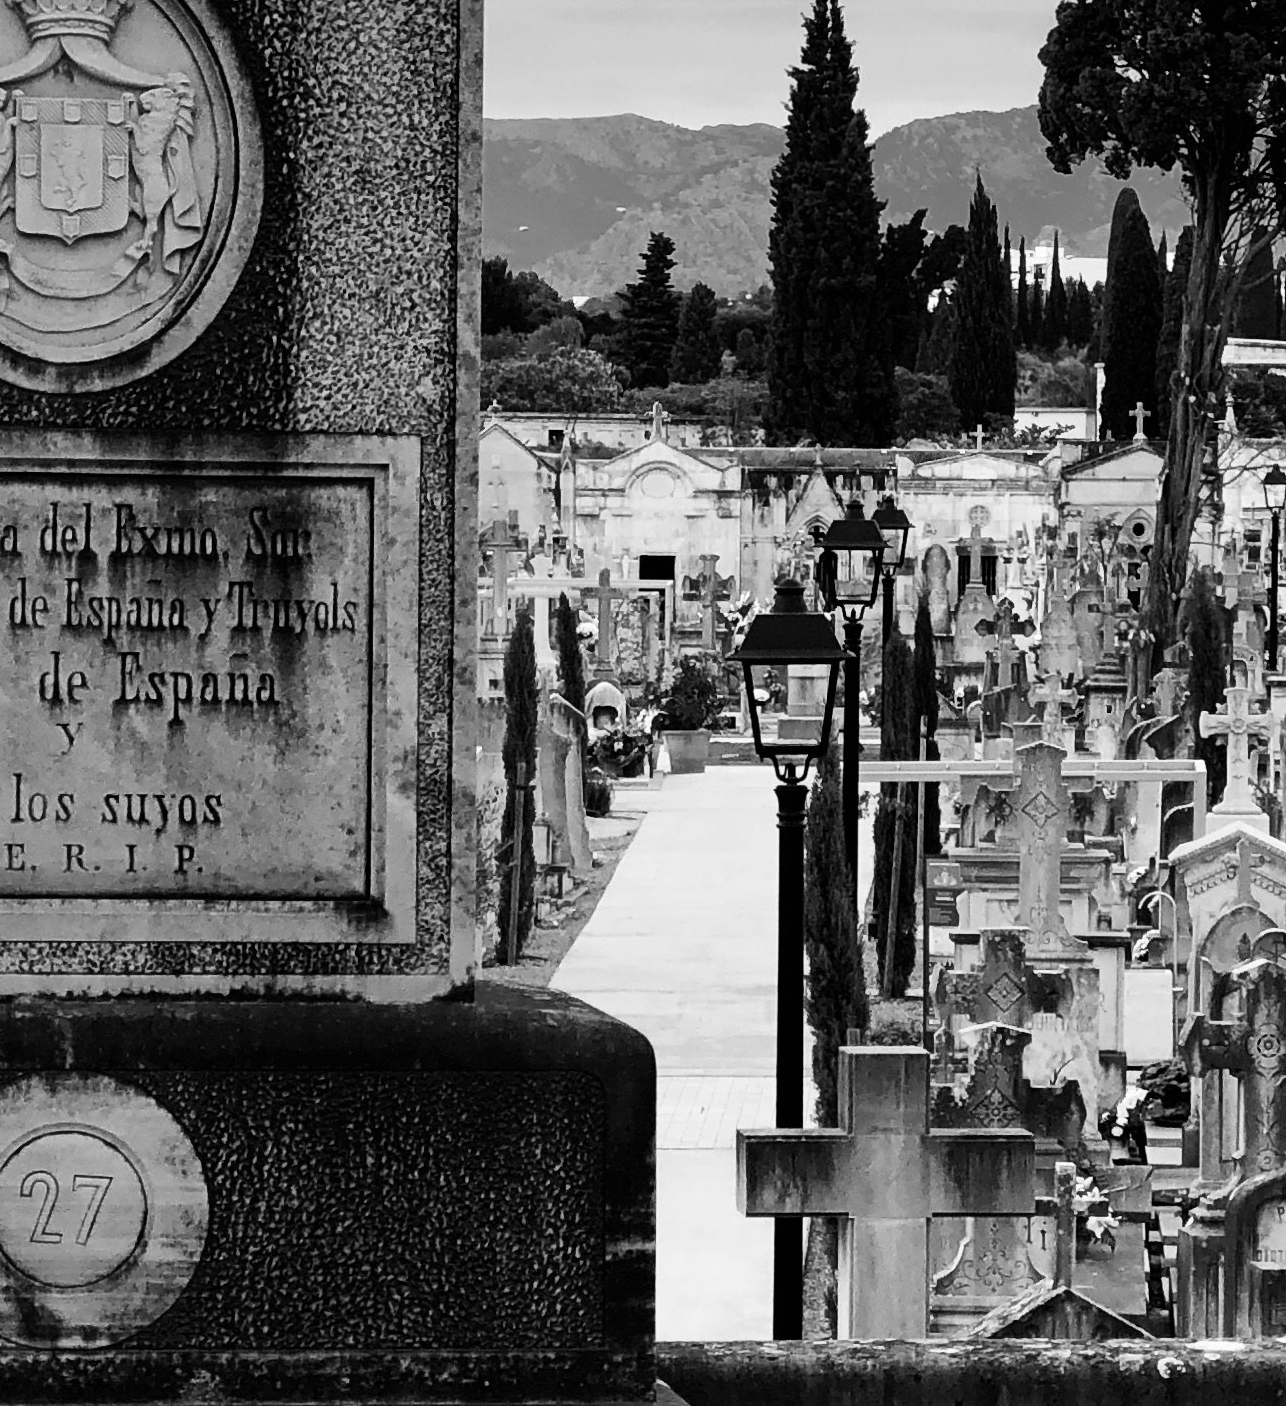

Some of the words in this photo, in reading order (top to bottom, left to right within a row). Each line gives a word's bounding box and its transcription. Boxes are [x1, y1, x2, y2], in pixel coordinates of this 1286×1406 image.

[39, 501, 94, 557] del
[9, 576, 50, 631] de
[62, 577, 190, 645] España
[199, 597, 222, 641] y
[227, 580, 358, 637] Truyols
[38, 650, 90, 704] de
[112, 650, 281, 726] España
[55, 721, 85, 756] y
[10, 772, 76, 824] los
[101, 792, 224, 837] suyos
[19, 1169, 114, 1246] 27
